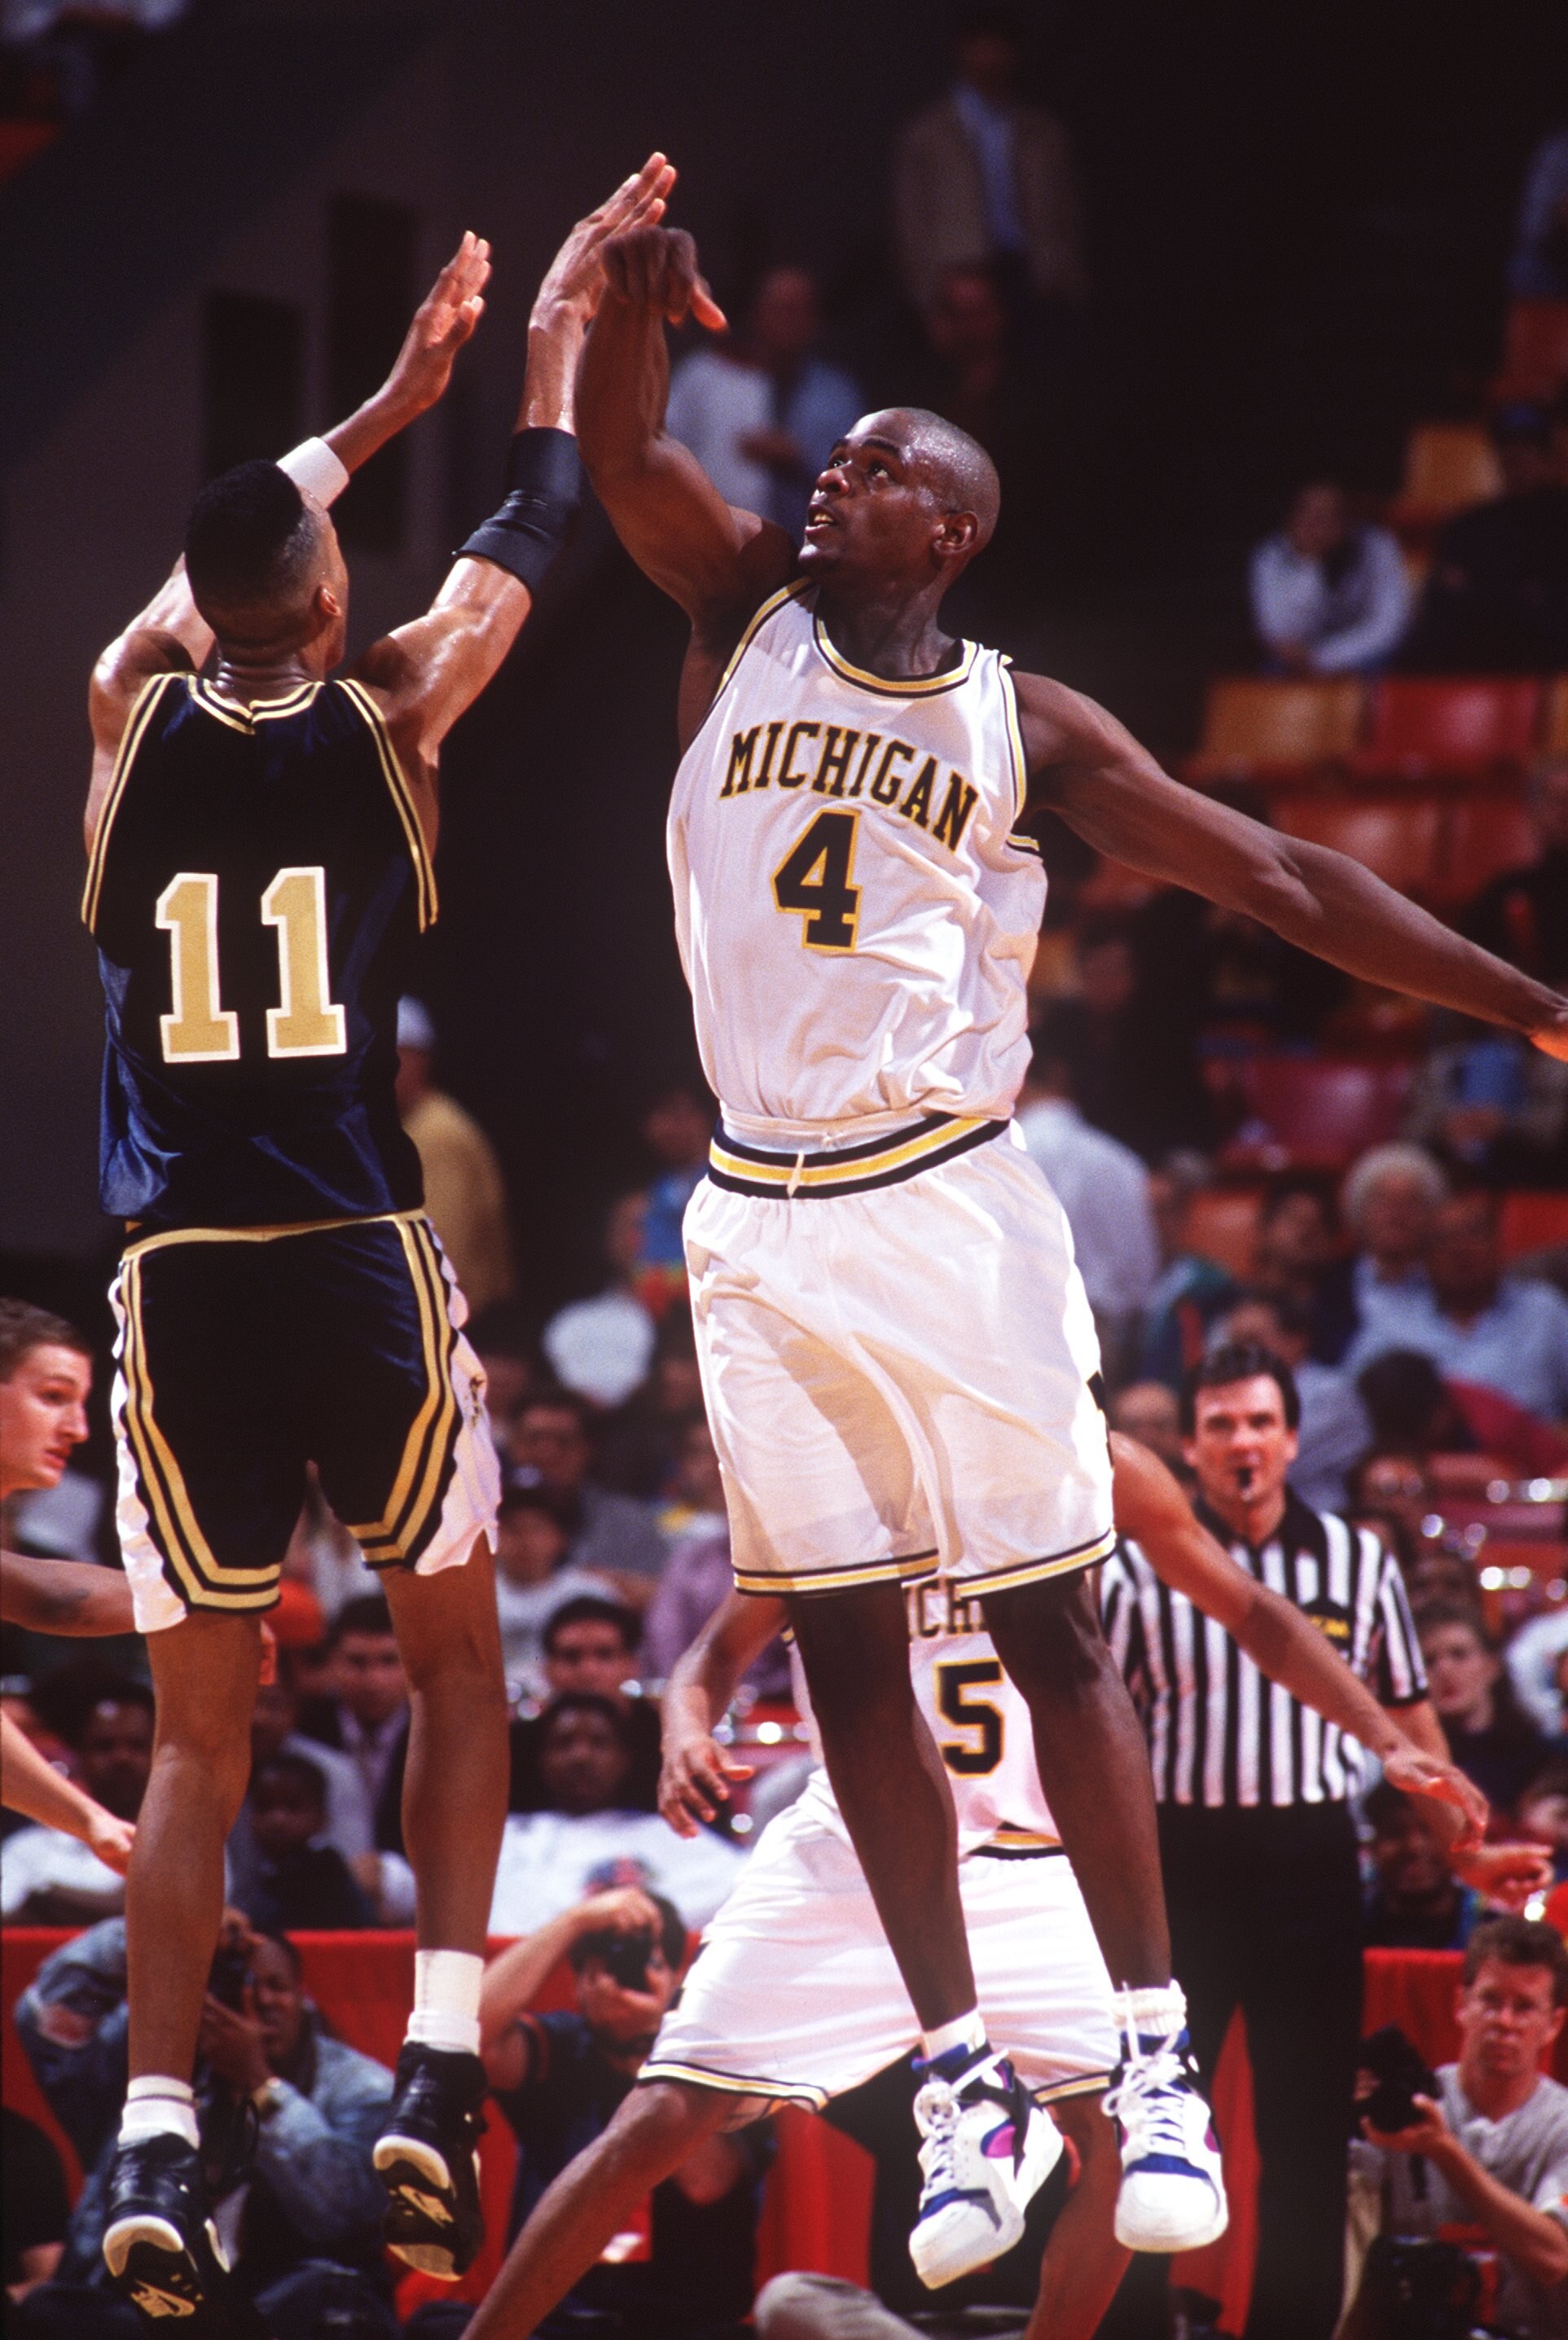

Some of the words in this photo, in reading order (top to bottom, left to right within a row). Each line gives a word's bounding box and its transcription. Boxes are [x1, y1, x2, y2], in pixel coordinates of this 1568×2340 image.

[718, 720, 979, 854] MICHIGAN
[771, 807, 863, 952] 4
[155, 865, 347, 1063] 11
[933, 1656, 1004, 1778] 5
